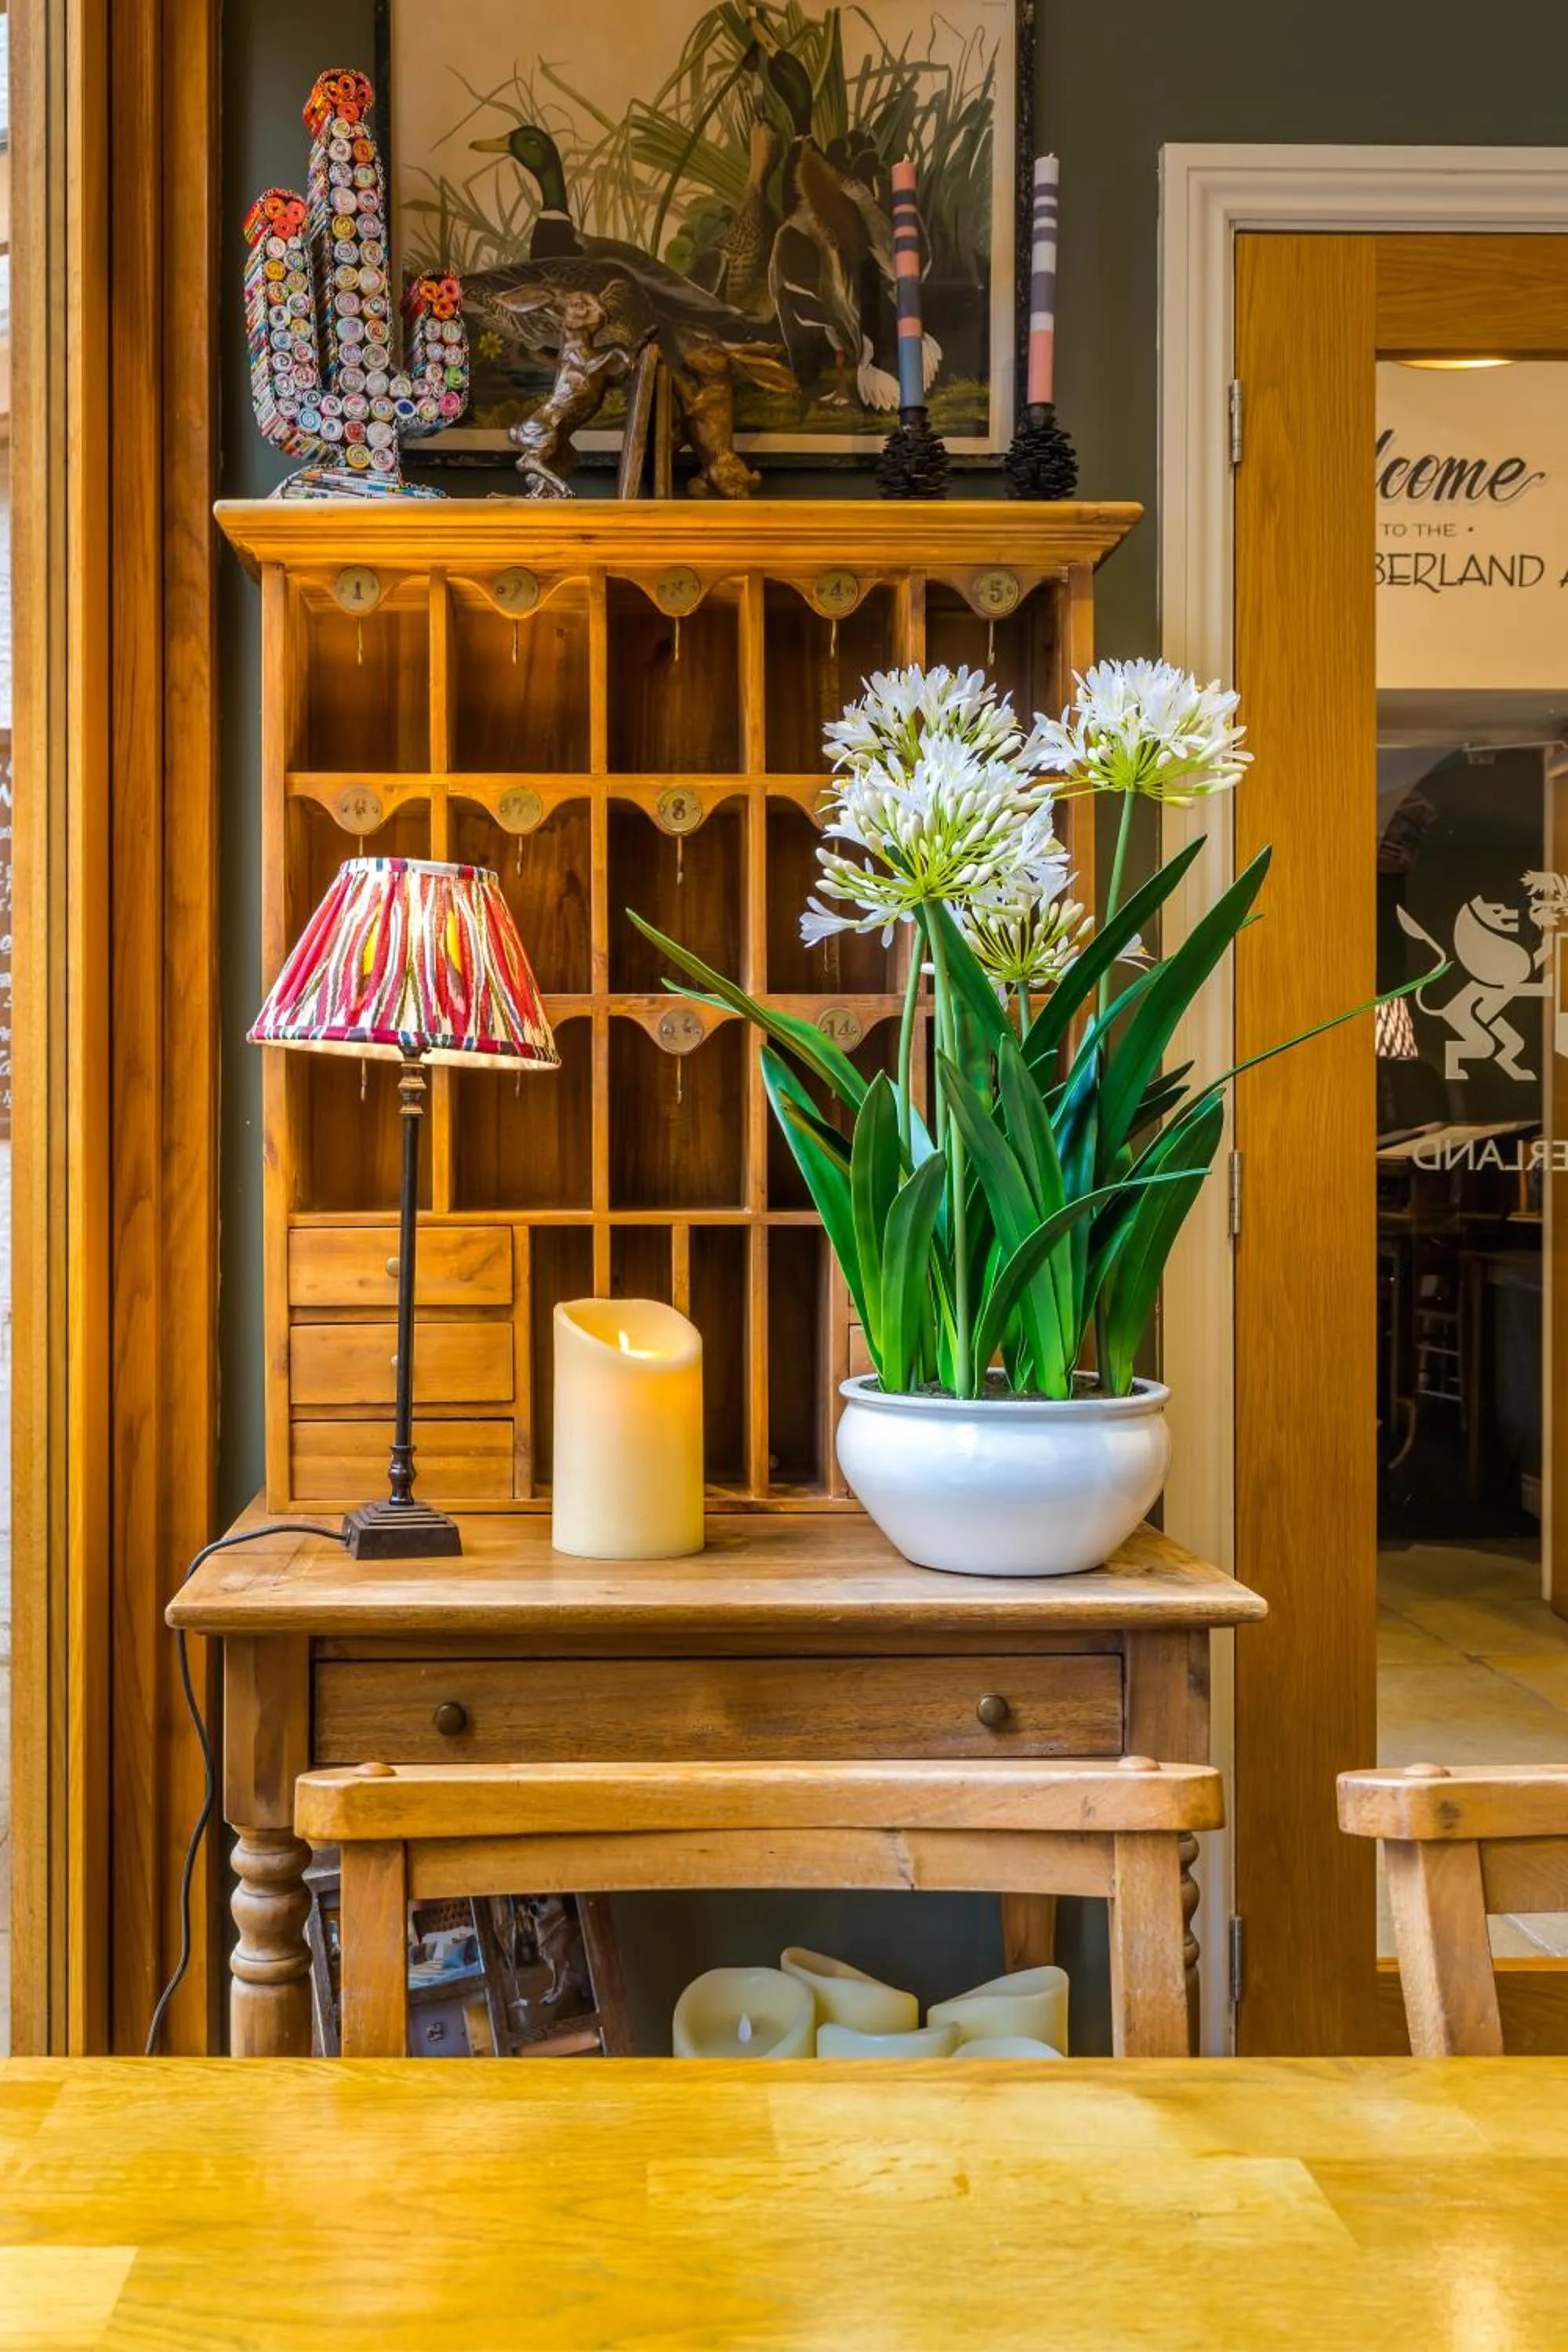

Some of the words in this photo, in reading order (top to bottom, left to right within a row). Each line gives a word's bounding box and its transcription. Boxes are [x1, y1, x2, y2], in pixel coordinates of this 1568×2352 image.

[1381, 523, 1408, 537] TO
[1413, 523, 1457, 537] THE
[352, 580, 364, 600] 1
[829, 579, 843, 601] 4
[990, 579, 1004, 603] 5
[671, 797, 686, 820] 8
[825, 1020, 850, 1040] 14
